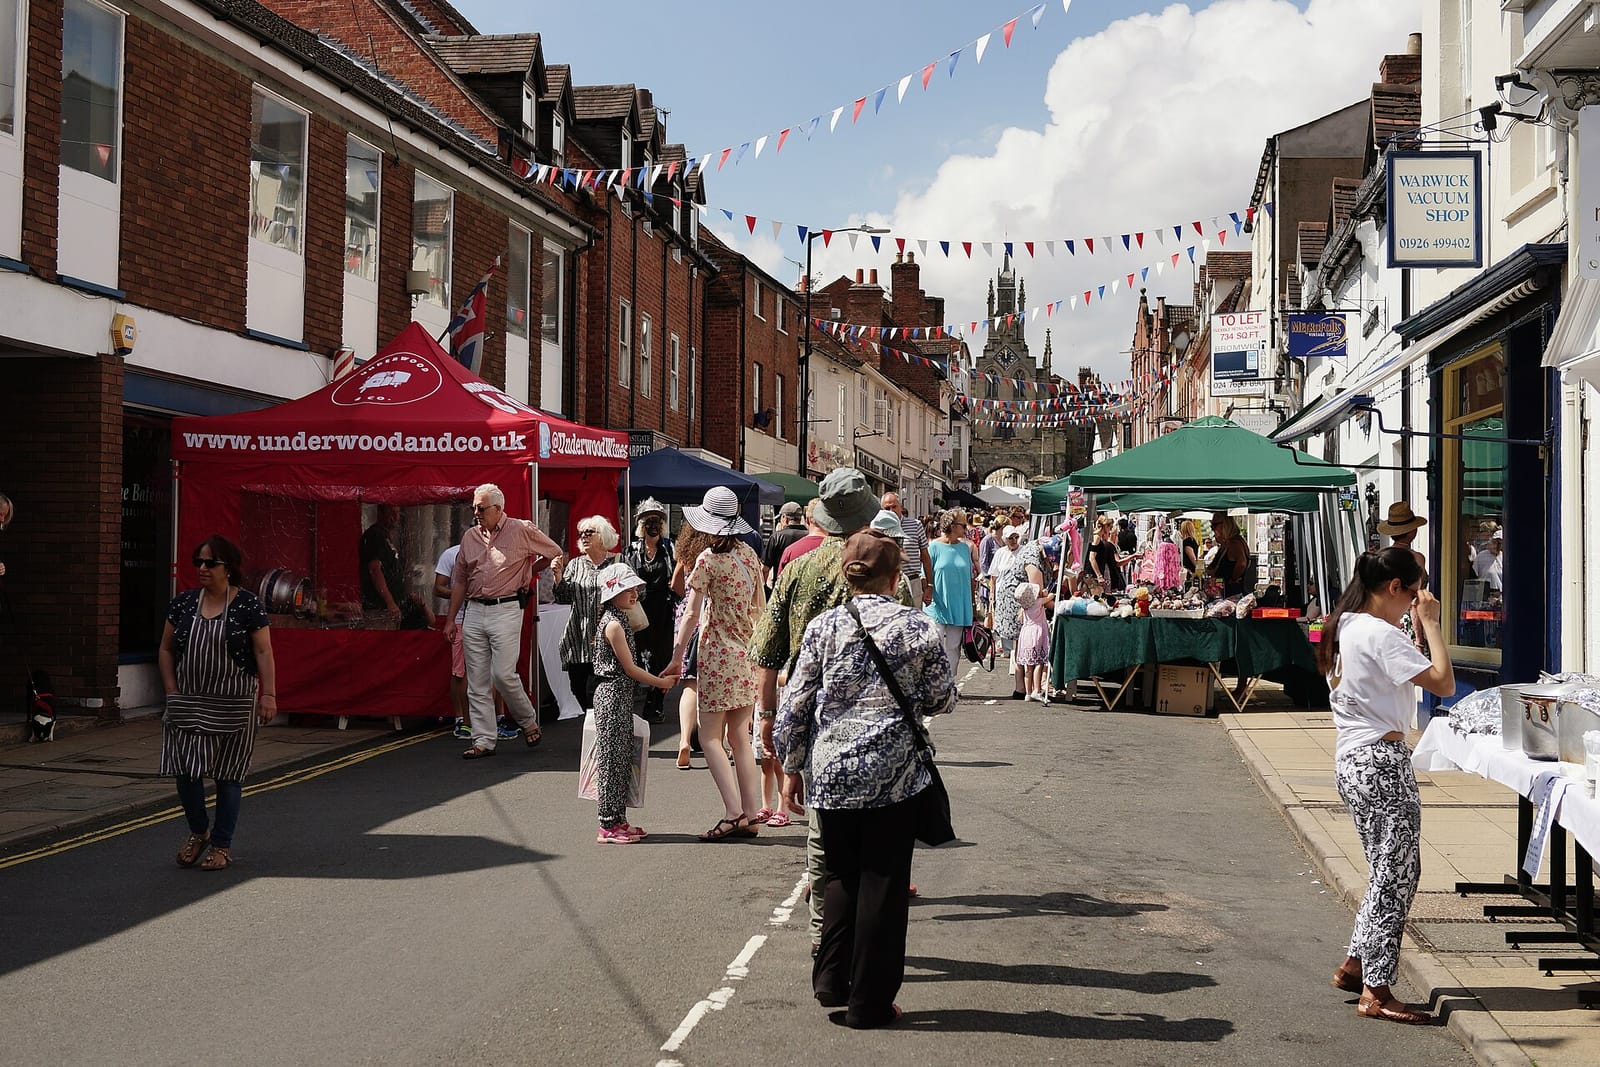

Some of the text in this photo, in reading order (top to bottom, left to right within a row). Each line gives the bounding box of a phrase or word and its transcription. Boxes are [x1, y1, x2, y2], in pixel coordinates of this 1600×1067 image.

[1399, 175, 1469, 187] WARWICK
[1407, 192, 1469, 204] VACUUM
[1425, 209, 1470, 221] SHOP
[1399, 238, 1470, 249] 01926 499402
[1219, 313, 1262, 326] TO LET
[1219, 333, 1234, 341] 734
[361, 356, 430, 376] UNDERWOOD
[1213, 382, 1227, 390] 024
[183, 431, 527, 453] www.underwoodandco.uk
[551, 431, 629, 460] @UnderwoodWines
[629, 445, 650, 456] ARPETS
